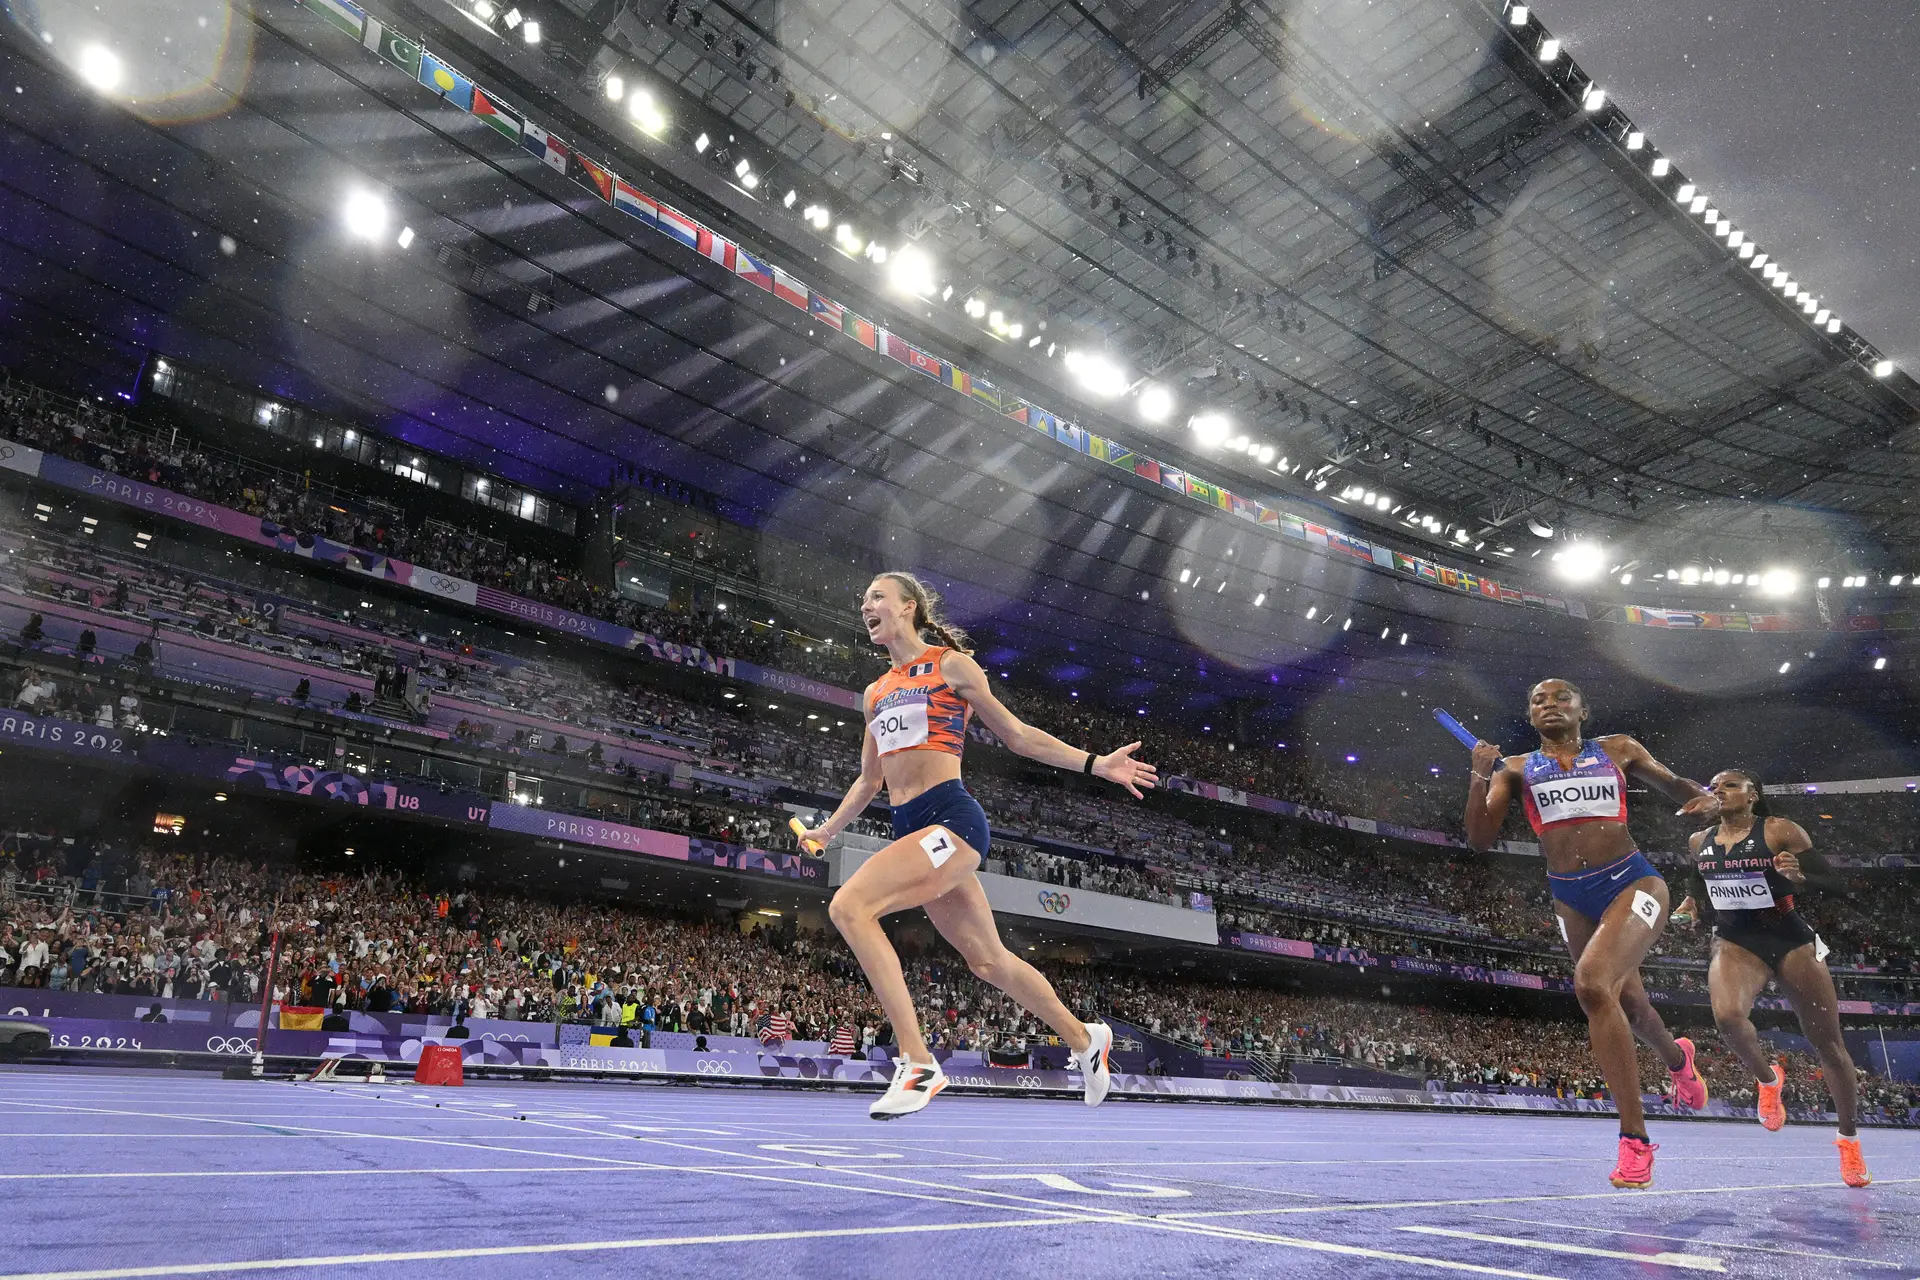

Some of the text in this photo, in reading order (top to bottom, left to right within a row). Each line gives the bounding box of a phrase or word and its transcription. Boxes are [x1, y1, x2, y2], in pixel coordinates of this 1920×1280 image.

[91, 474, 218, 523] PARIS 2024
[510, 601, 596, 634] PARIS 2024
[762, 671, 829, 697] PARIS 2024
[880, 715, 909, 737] BOL
[398, 795, 420, 810] U8
[1537, 785, 1616, 808] BROWN
[468, 806, 487, 821] U7
[547, 819, 640, 845] PARIS 2024
[931, 837, 949, 853] 7
[1724, 858, 1772, 869] BRITAIN
[801, 865, 816, 878] U6
[1710, 884, 1768, 898] ANNING
[1249, 937, 1293, 952] PARIS 2024
[1406, 960, 1424, 969] PARIS
[570, 1058, 658, 1072] PARIS 2024
[964, 1076, 991, 1086] 2024
